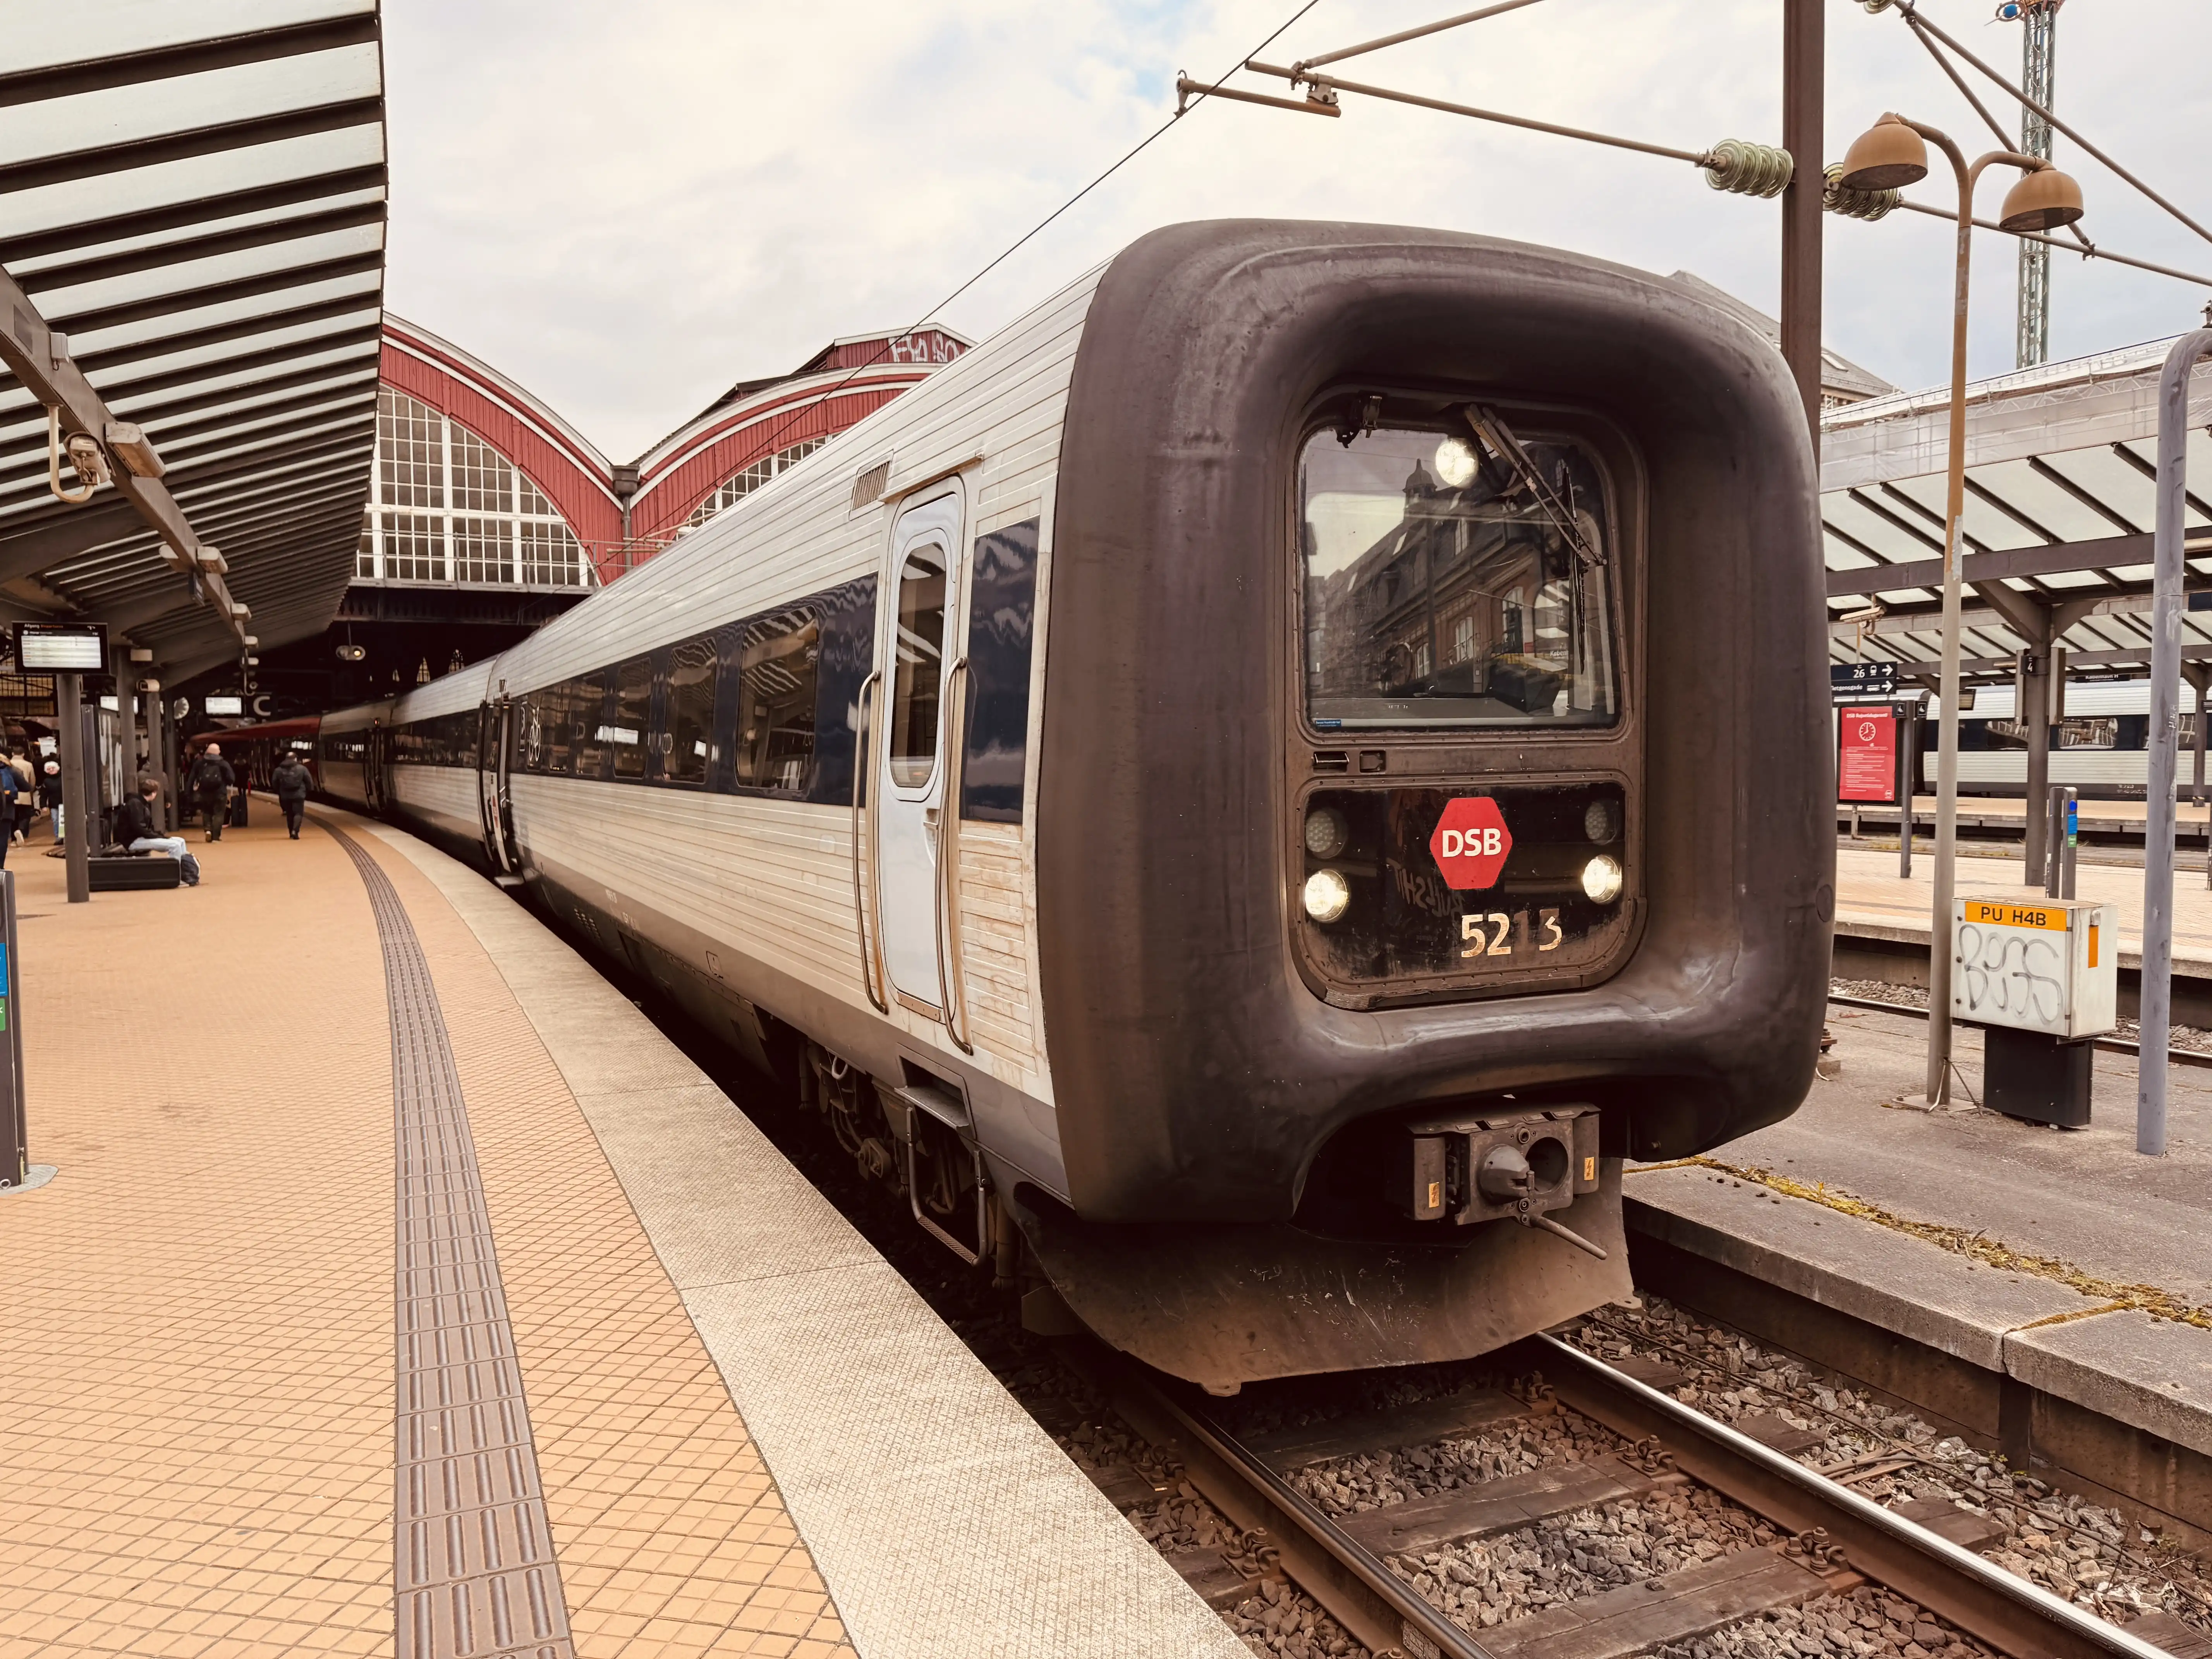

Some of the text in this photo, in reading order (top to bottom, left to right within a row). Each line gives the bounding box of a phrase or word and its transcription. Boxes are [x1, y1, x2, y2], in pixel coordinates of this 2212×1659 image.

[1853, 669, 1865, 678] 26
[2028, 663, 2033, 672] 4
[253, 696, 271, 716] C
[1442, 828, 1502, 858] DSB
[1981, 907, 2047, 926] PU H4B
